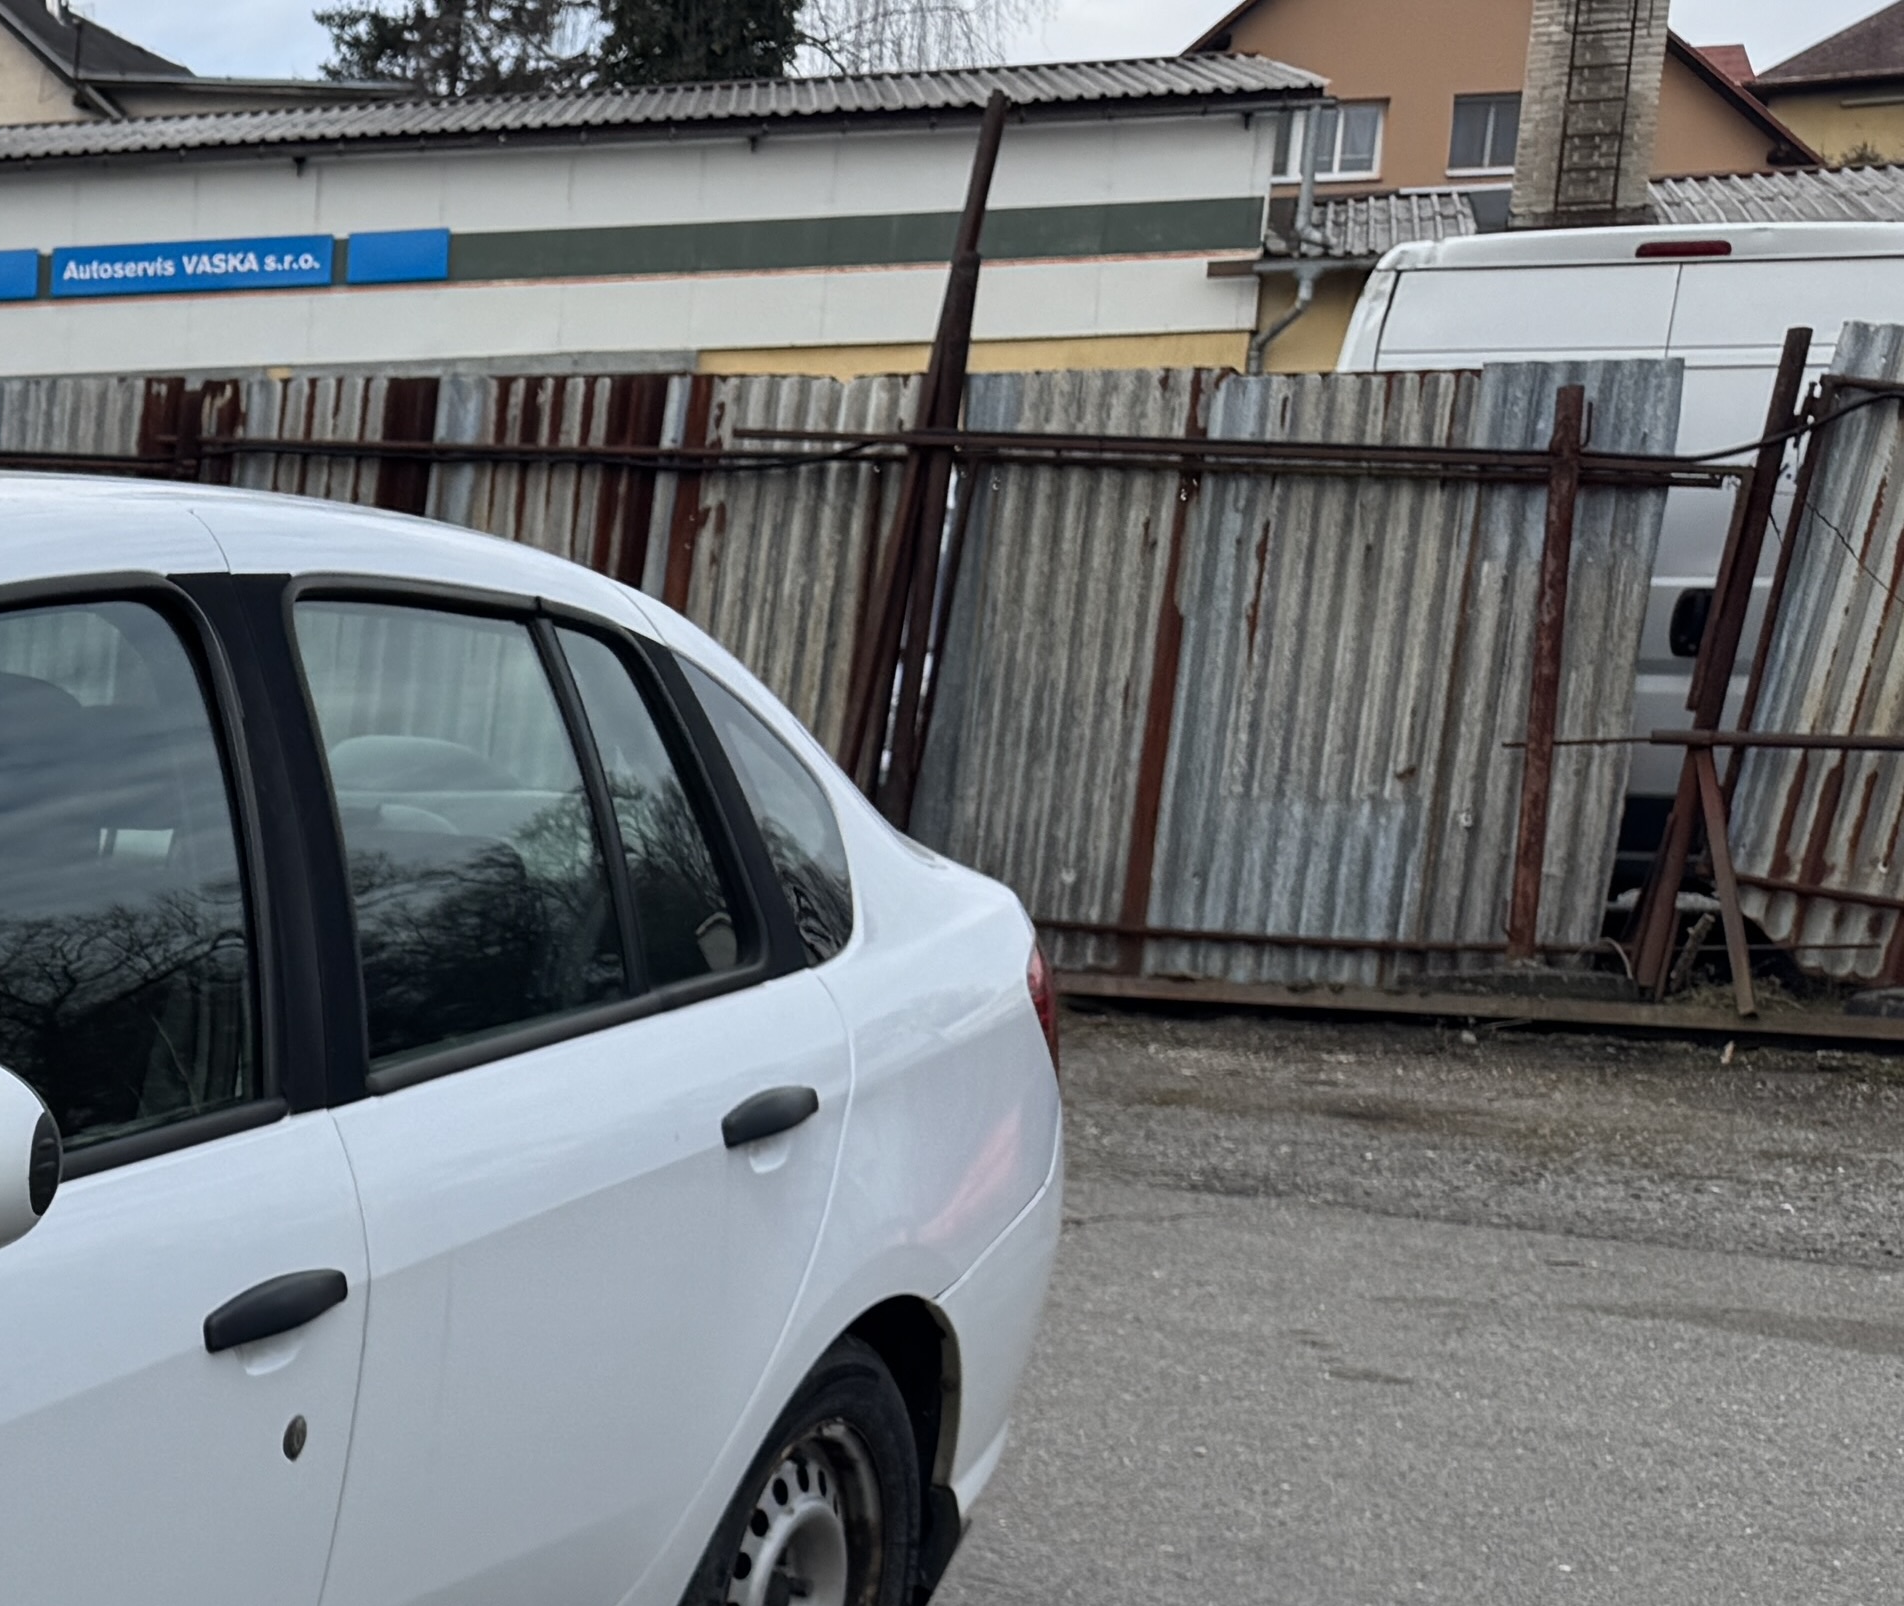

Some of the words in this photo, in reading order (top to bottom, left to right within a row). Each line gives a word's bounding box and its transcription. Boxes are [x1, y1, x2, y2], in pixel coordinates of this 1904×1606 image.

[63, 256, 176, 280] Autoservis
[182, 251, 259, 275] VASKA
[263, 253, 321, 272] s.r.o.
